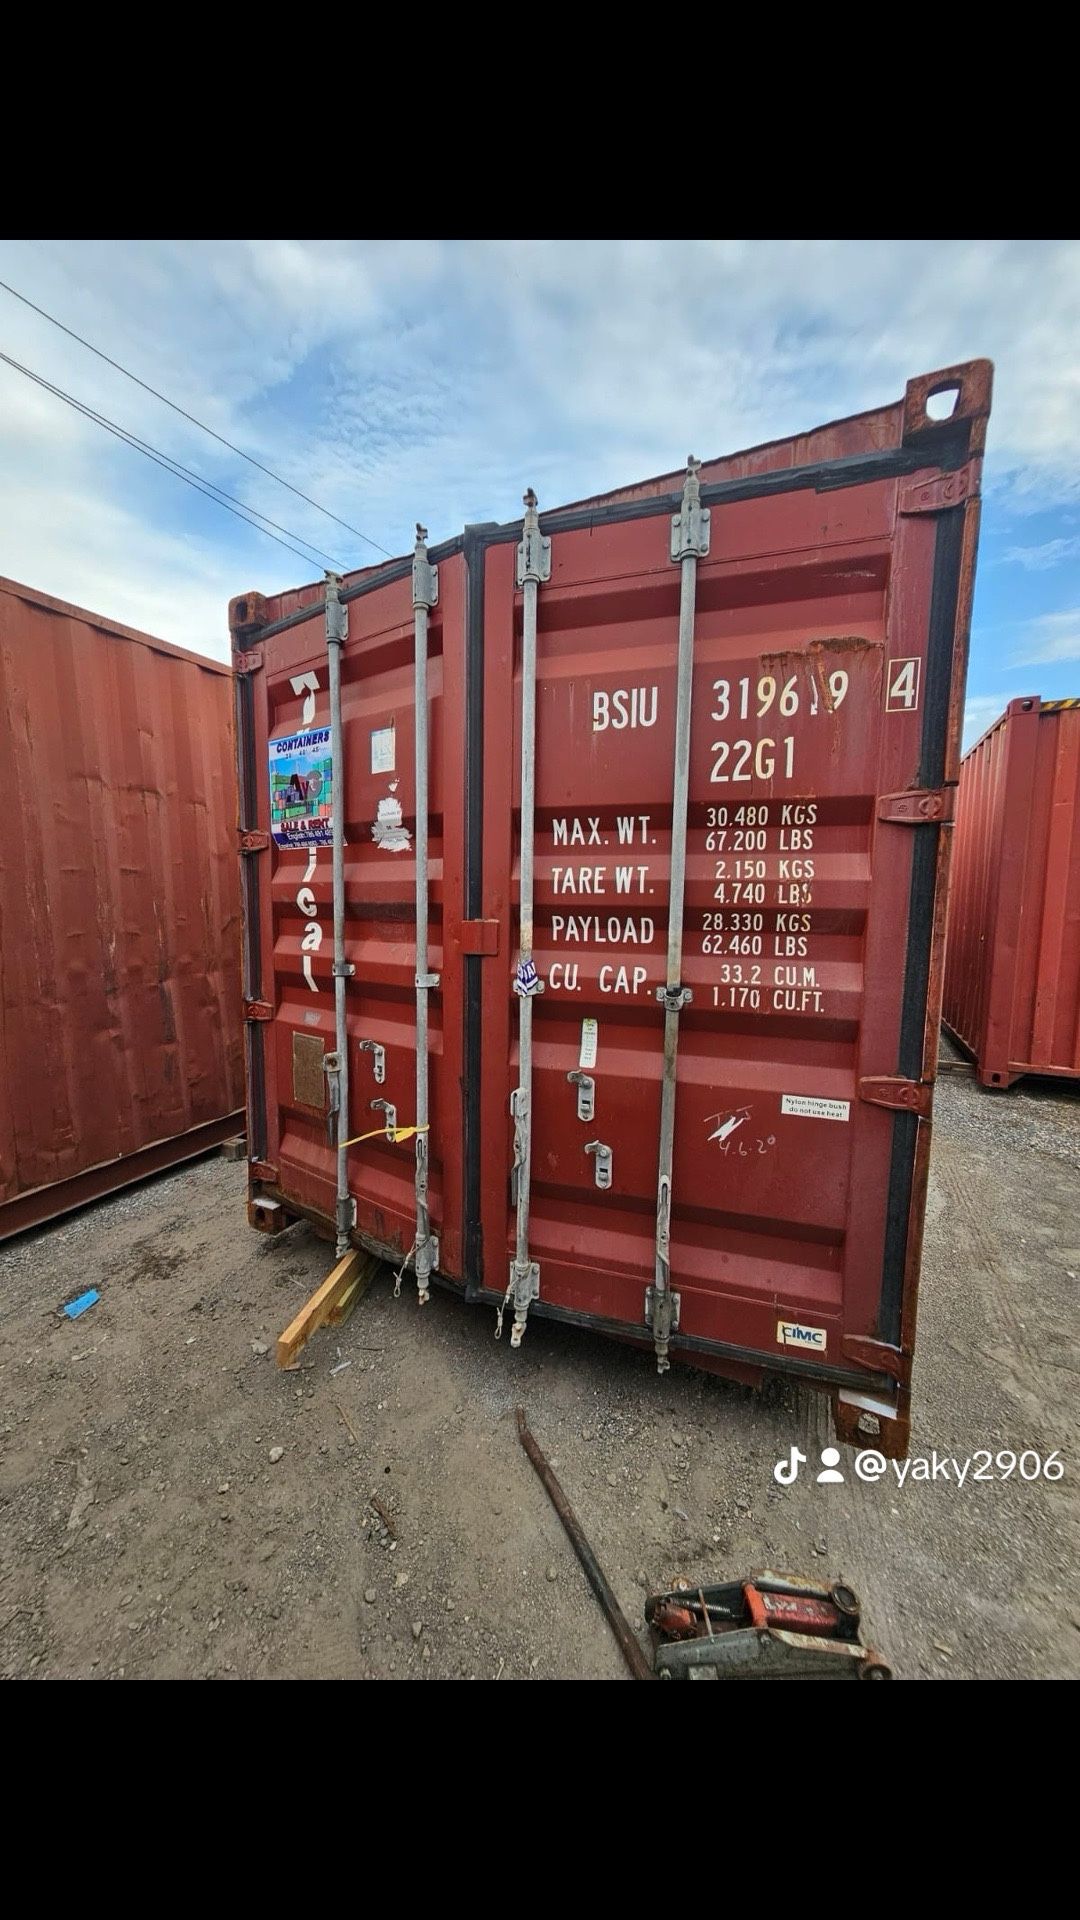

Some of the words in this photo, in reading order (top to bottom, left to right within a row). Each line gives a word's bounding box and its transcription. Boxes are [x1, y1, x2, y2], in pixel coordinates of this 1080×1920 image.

[593, 687, 658, 731] BSIU
[890, 662, 915, 708] 4
[276, 730, 330, 754] CONTAINERS
[710, 736, 795, 782] 22G1
[552, 818, 609, 846] MAX.
[617, 815, 657, 845] WT.
[706, 806, 768, 828] 30.480
[781, 804, 818, 825] KGS
[705, 830, 767, 851] 67.200
[779, 829, 814, 851] LBS
[552, 867, 606, 894] TARE
[615, 866, 655, 893] WT.
[715, 861, 766, 880] 2.150
[779, 859, 815, 879] KGS
[713, 884, 765, 904] 4.740
[778, 883, 812, 905] LBS
[552, 916, 655, 944] PAYLOAD
[702, 913, 763, 932] 28.330
[776, 914, 811, 933] KGS
[702, 935, 762, 955] 62.460
[774, 936, 808, 957] LBS
[549, 963, 581, 991] CU.
[599, 965, 652, 995] CAP.
[720, 964, 761, 984] 33.2
[774, 965, 821, 988] CU.M.
[713, 987, 760, 1008] 1.170
[773, 990, 825, 1013] CU.FT.
[785, 1097, 806, 1106] Nylon
[807, 1100, 828, 1109] hinge
[782, 1326, 823, 1344] CIMC
